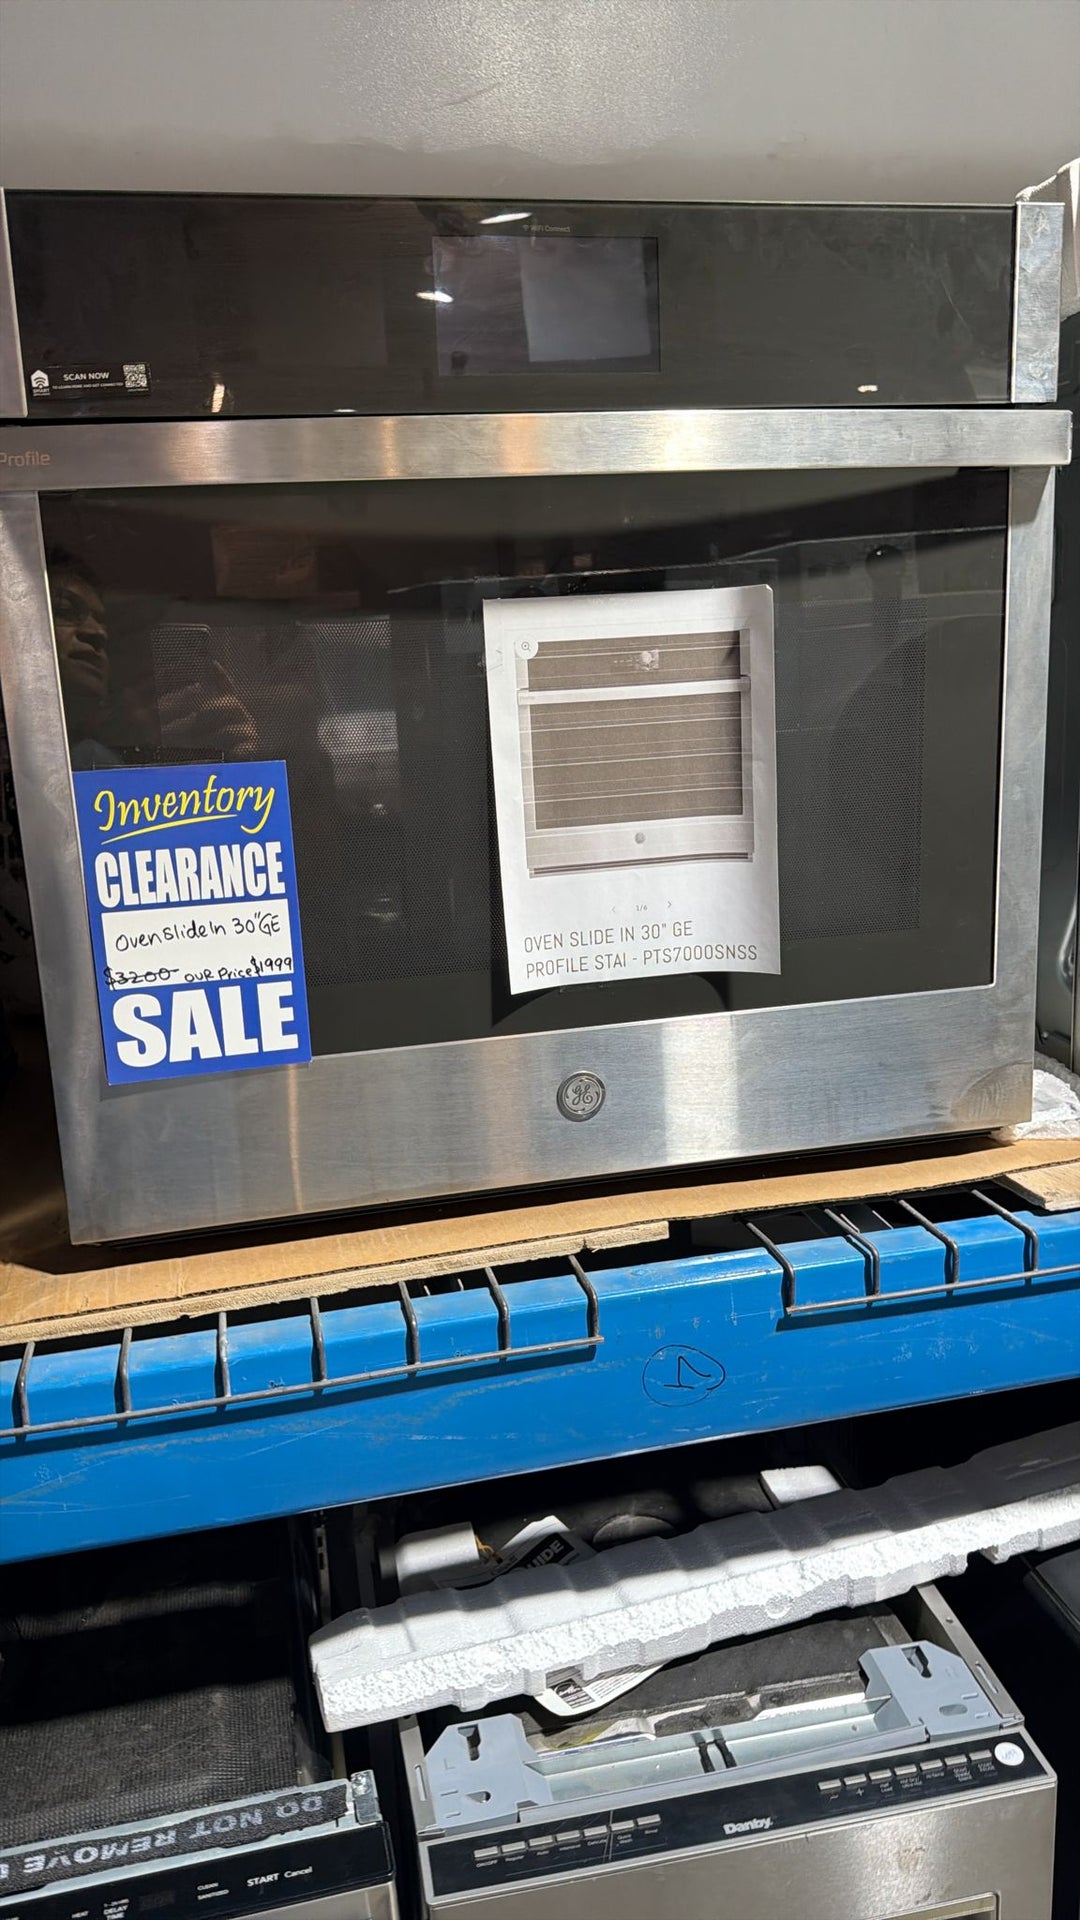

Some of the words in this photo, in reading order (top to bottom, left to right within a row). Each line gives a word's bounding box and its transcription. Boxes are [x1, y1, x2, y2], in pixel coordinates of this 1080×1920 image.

[63, 373, 87, 381] SCAN
[88, 372, 110, 380] NOW
[0, 451, 50, 467] Profile
[93, 774, 276, 834] Inventory
[94, 841, 286, 908] CLEARANCE
[524, 933, 563, 954] OVEN
[569, 928, 615, 948] SLIDE
[620, 926, 635, 943] IN
[641, 922, 667, 941] 30"
[672, 920, 693, 938] GE
[250, 955, 292, 977] $1999
[526, 955, 589, 979] PROFILE
[594, 952, 627, 970] STAI
[643, 944, 758, 966] PTS7000SNSS
[112, 980, 299, 1068] SALE
[526, 1540, 565, 1568] UIDE
[276, 1796, 322, 1818] DO
[189, 1808, 263, 1839] NOT
[723, 1816, 772, 1835] Danby
[24, 1830, 176, 1873] REMOVE
[246, 1872, 280, 1887] START
[284, 1866, 313, 1879] Cancel
[103, 1905, 128, 1915] DELAY
